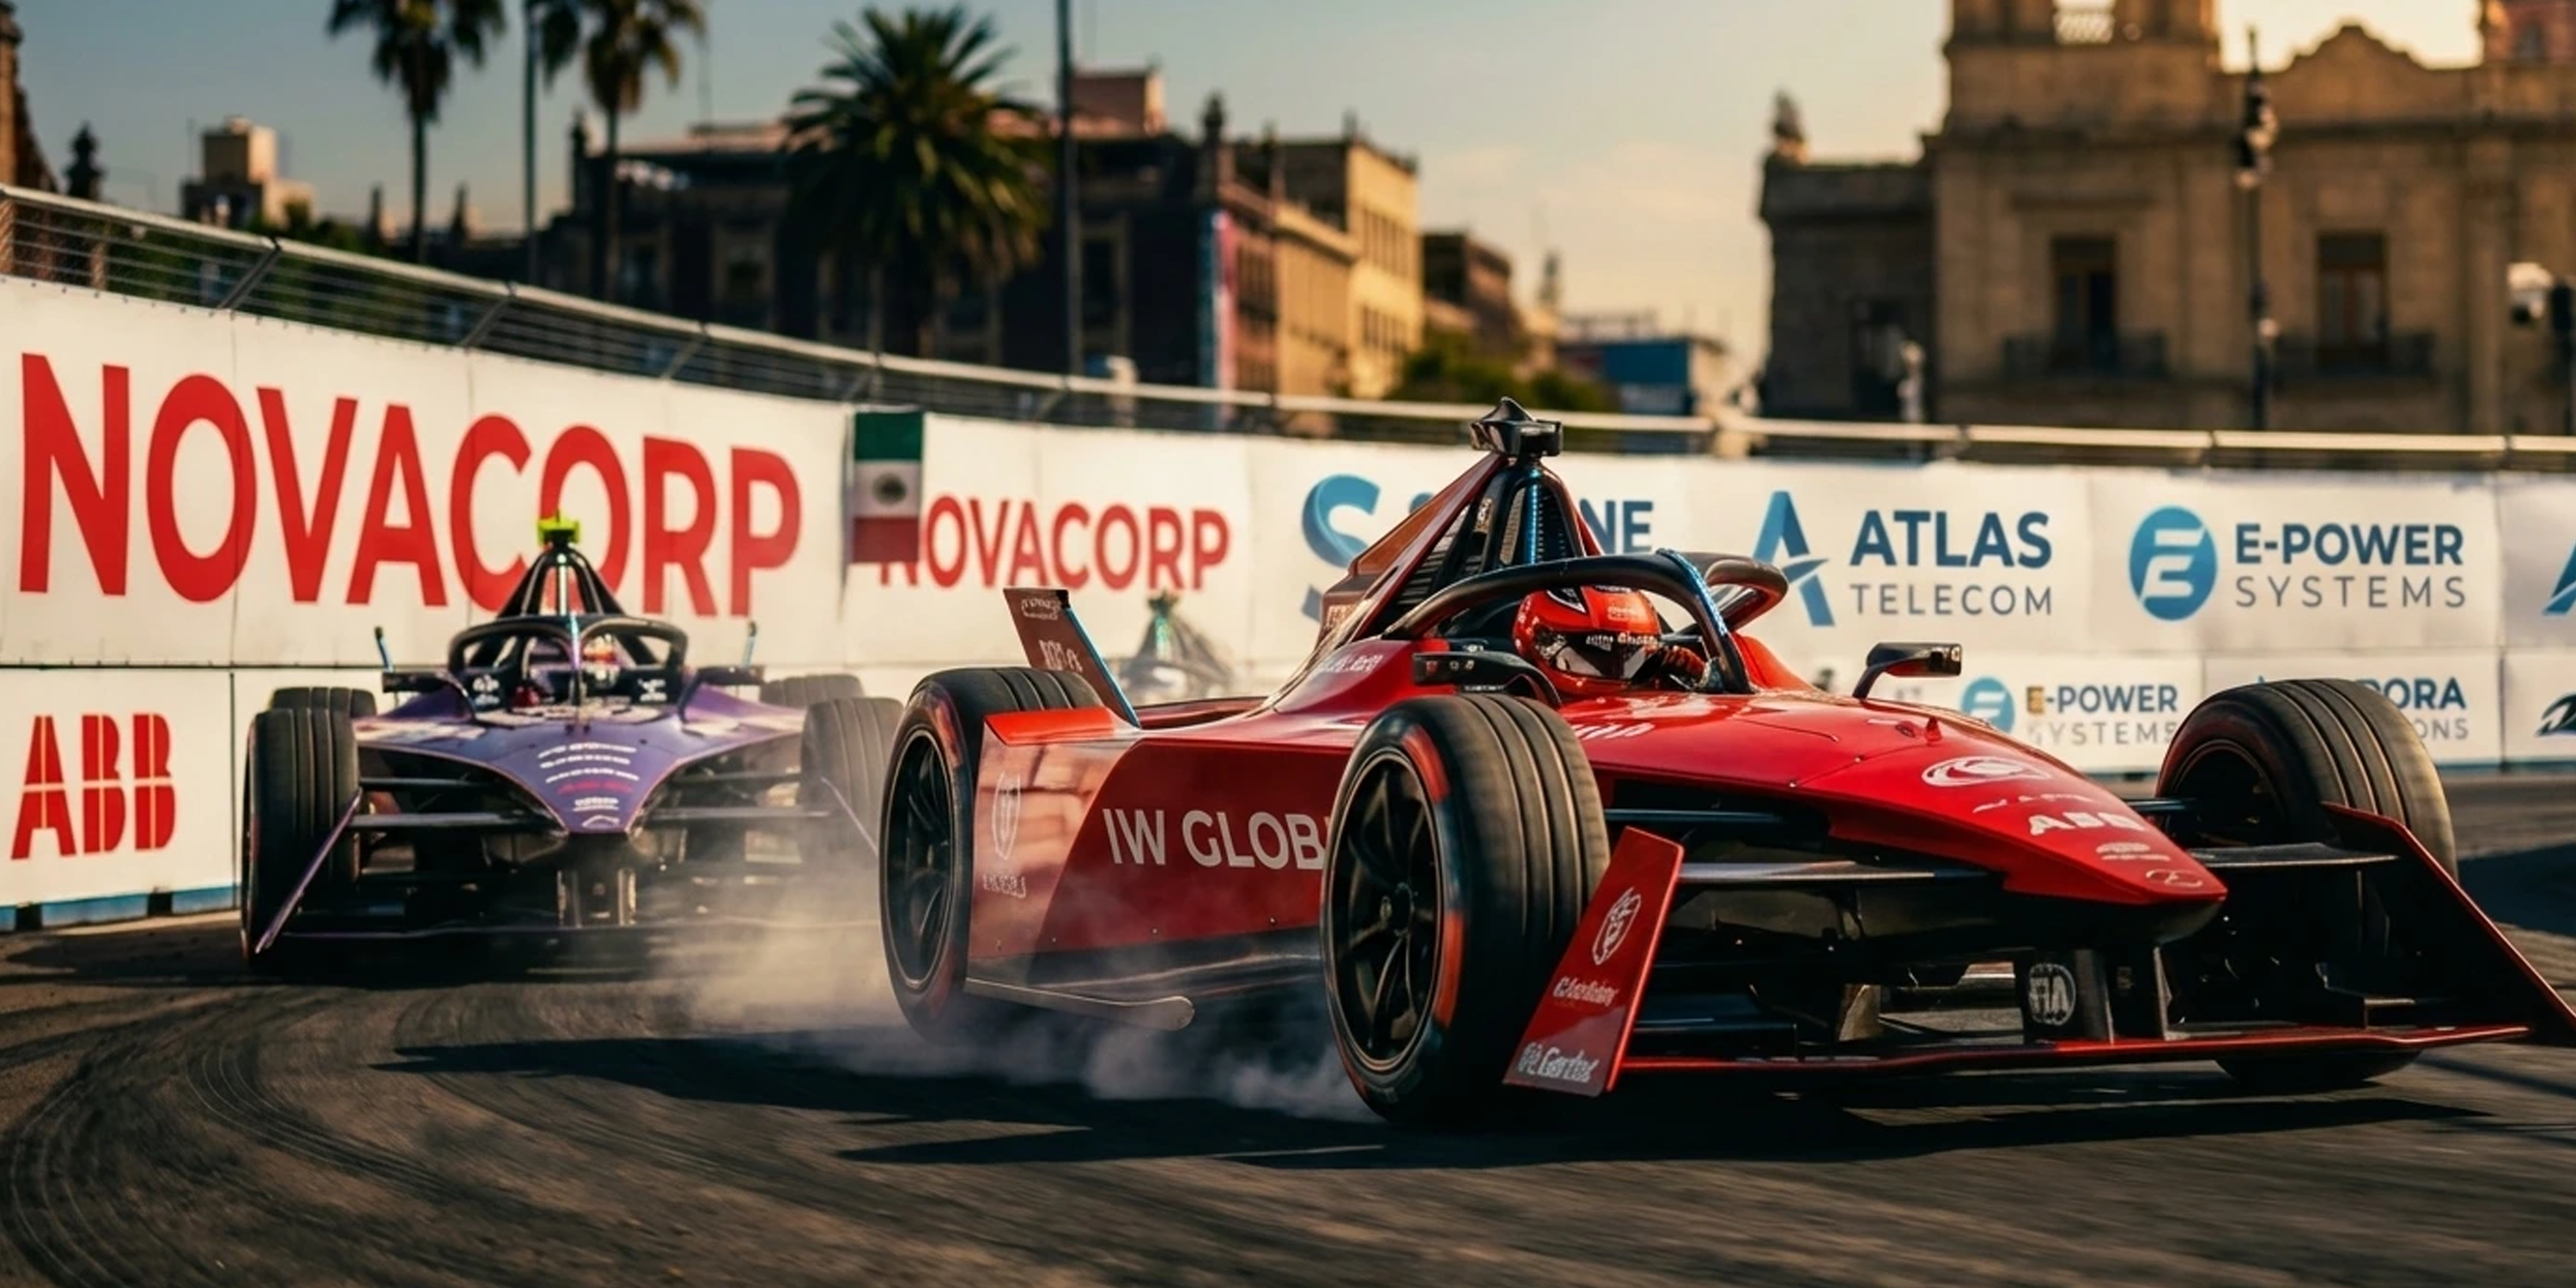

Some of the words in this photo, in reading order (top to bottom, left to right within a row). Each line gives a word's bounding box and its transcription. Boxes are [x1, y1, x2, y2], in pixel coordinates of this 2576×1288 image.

[19, 352, 802, 617] NOVACORP
[1849, 509, 2052, 569] ATLAS
[2235, 523, 2464, 565] E-POWER
[1850, 583, 2052, 616] TELECOM
[2235, 575, 2466, 608] SYSTEMS
[2357, 677, 2467, 710] ORA
[11, 714, 177, 860] ABB
[1103, 808, 1166, 866] IW
[1182, 810, 1332, 870] GLOB
